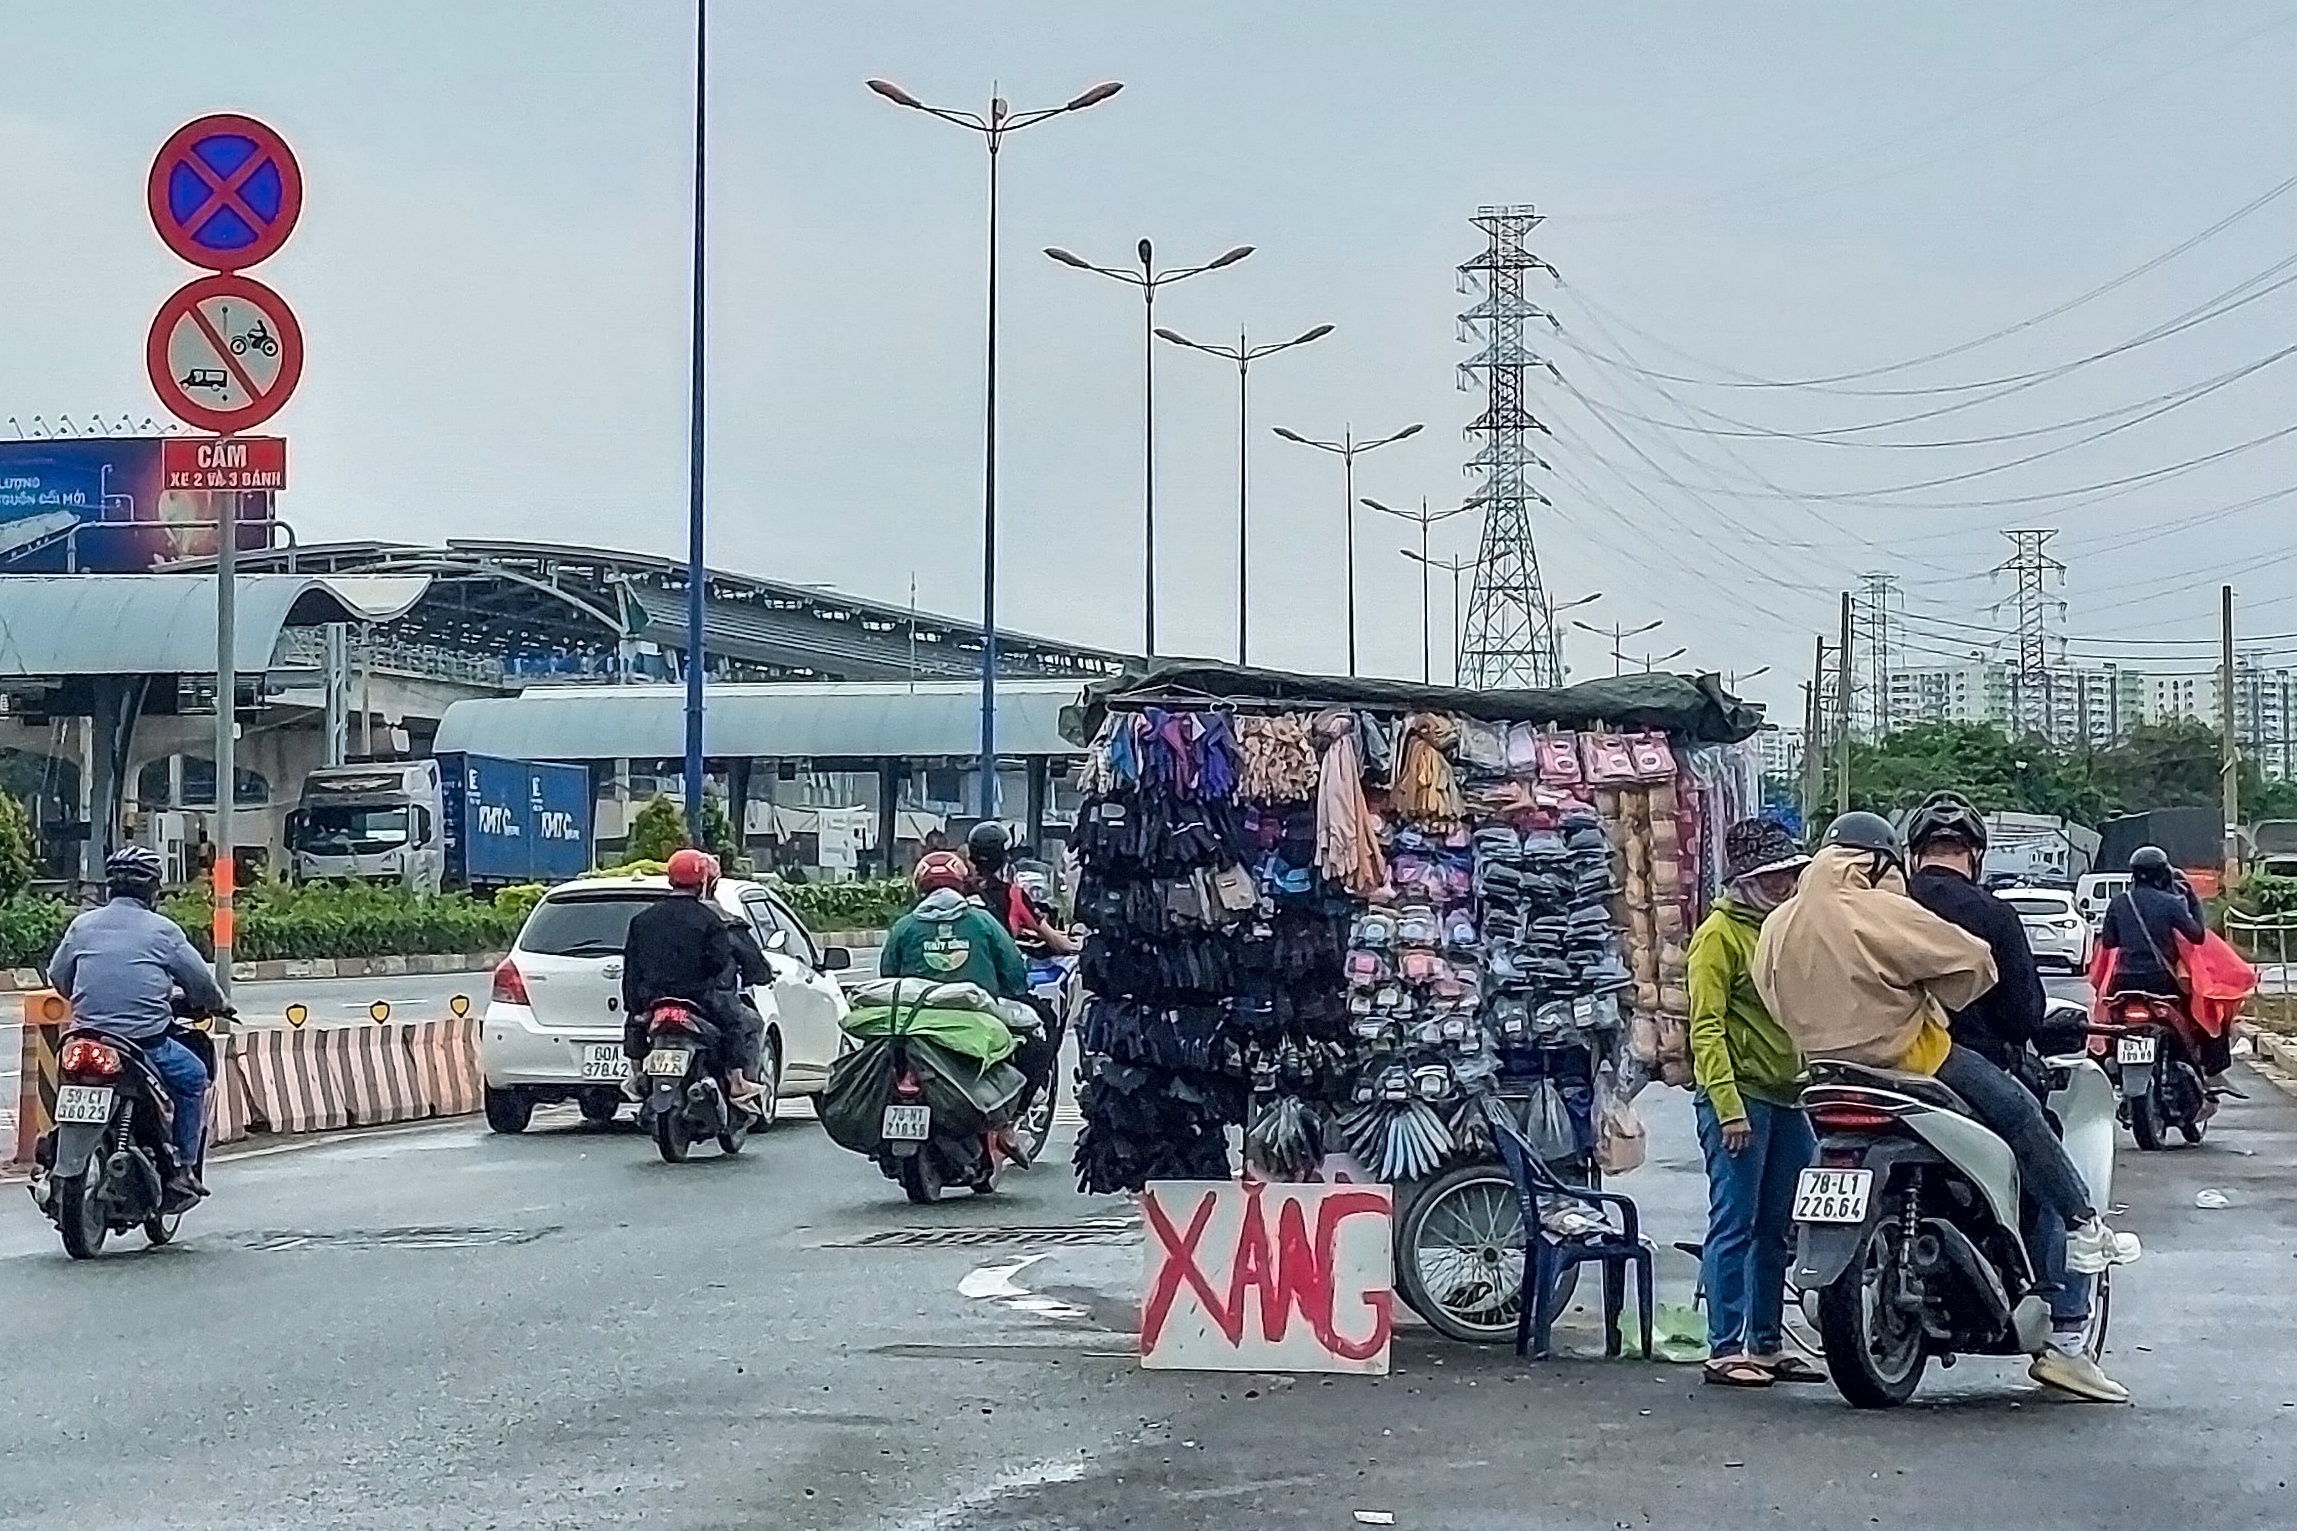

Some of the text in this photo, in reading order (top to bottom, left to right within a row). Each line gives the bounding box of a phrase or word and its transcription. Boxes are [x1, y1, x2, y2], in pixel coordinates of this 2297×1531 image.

[197, 440, 247, 468] CẤM
[170, 468, 280, 487] XE 2 VÀ 3 BÁNH
[1809, 1173, 1859, 1195] 78-L1
[1798, 1196, 1861, 1218] 226.64
